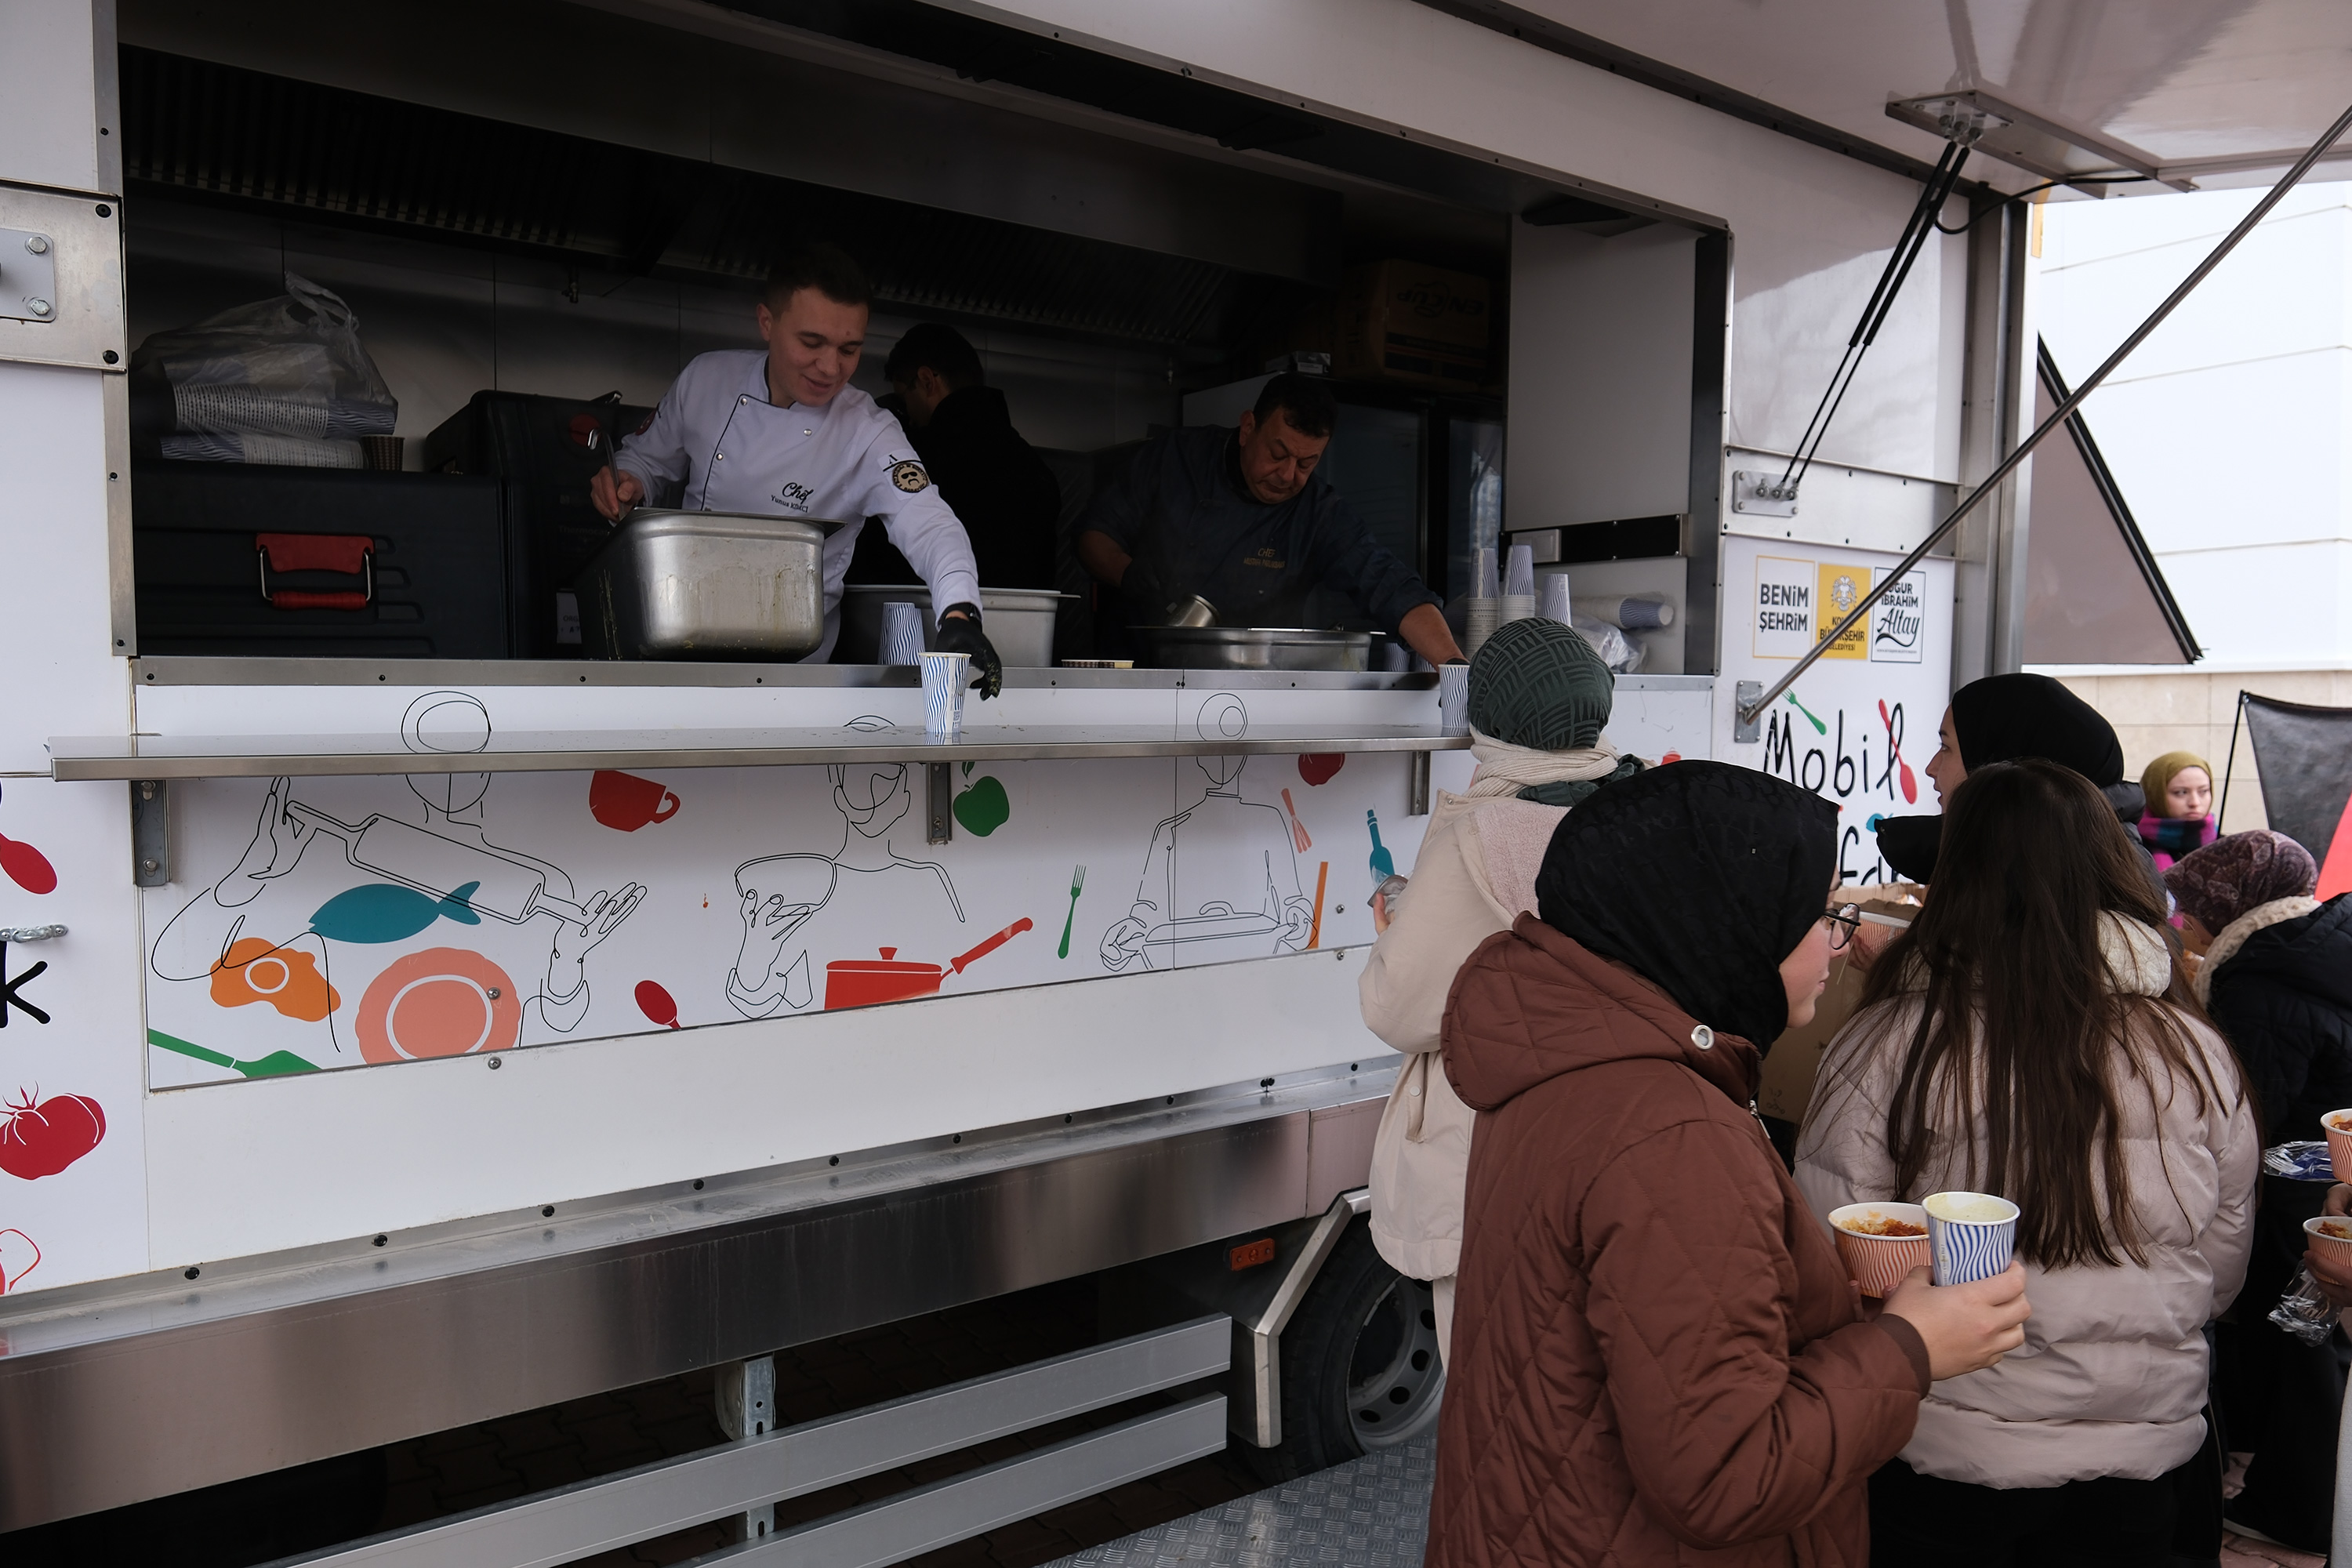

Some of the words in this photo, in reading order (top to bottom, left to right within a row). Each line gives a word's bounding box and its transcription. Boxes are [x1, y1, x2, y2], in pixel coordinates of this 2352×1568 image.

[771, 495, 789, 507] Yunus
[782, 482, 814, 504] Chef
[1875, 607, 1920, 648] Altay
[1763, 702, 1904, 800] Mobil
